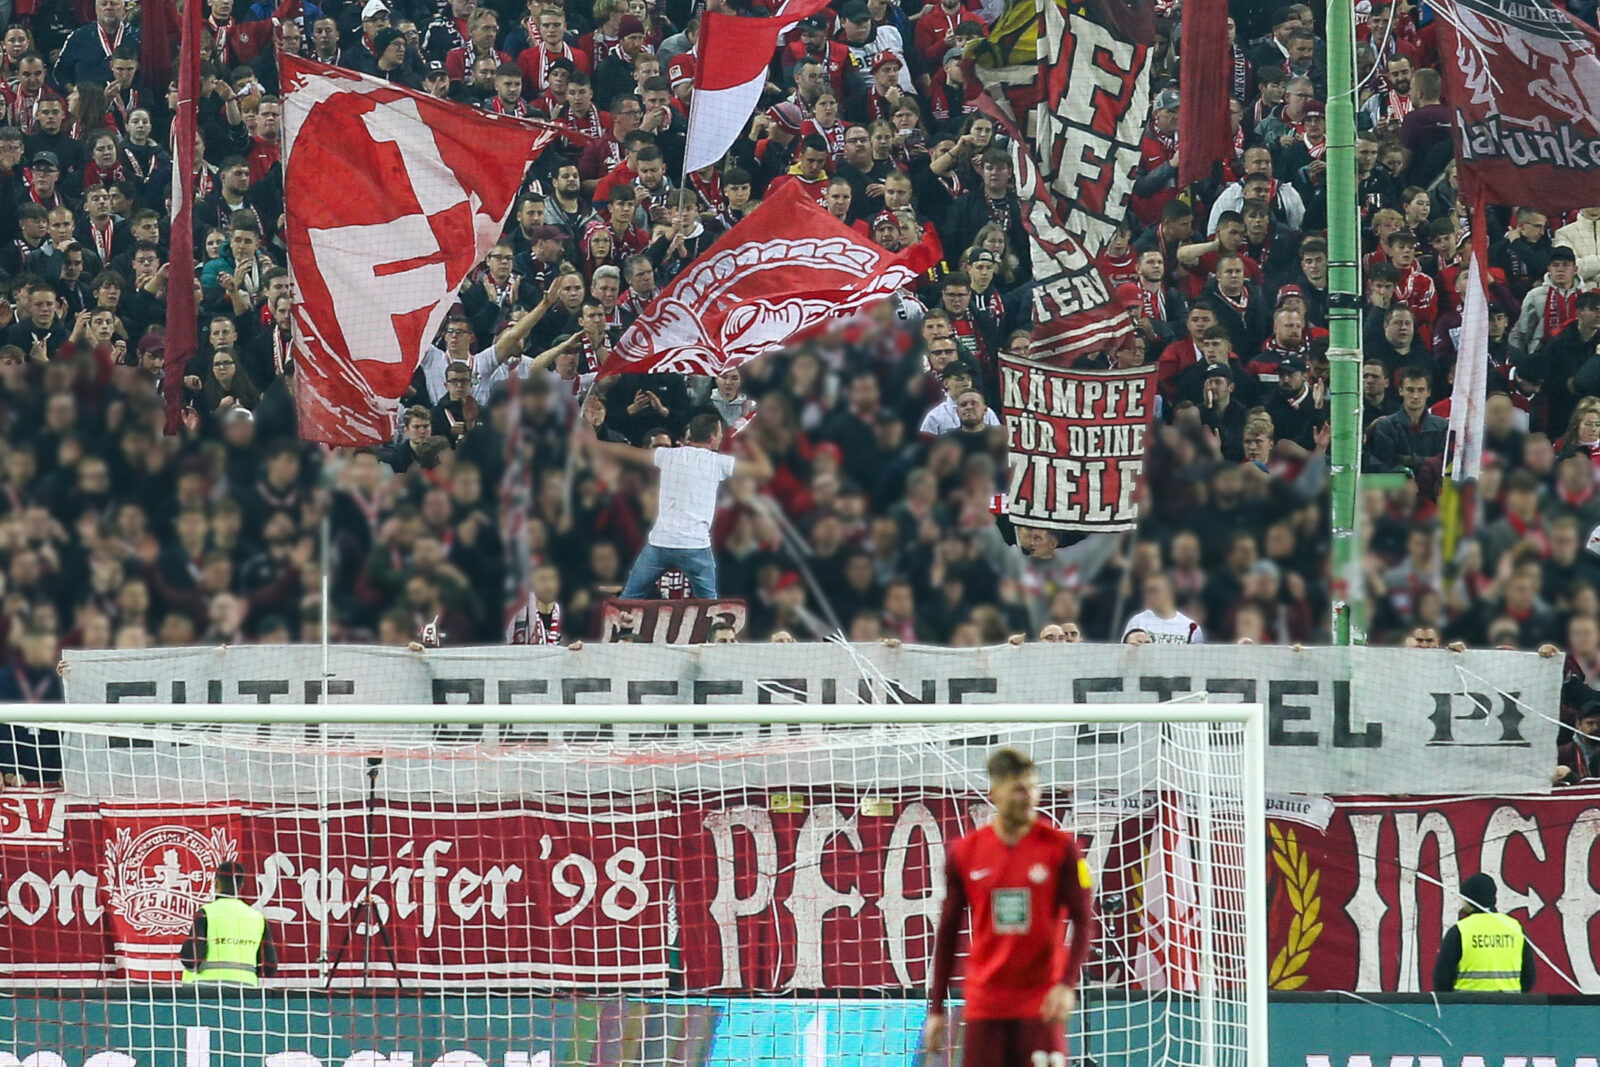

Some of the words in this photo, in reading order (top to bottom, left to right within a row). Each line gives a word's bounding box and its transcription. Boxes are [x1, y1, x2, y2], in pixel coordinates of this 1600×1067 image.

[1001, 366, 1146, 419] KÄMPFE
[1005, 411, 1057, 453] FÜR
[1068, 423, 1147, 457] DEINE
[1008, 452, 1143, 521] ZIELE
[255, 840, 523, 938] Luzifer
[215, 937, 257, 945] SECURITY
[1472, 934, 1515, 949] SECURITY
